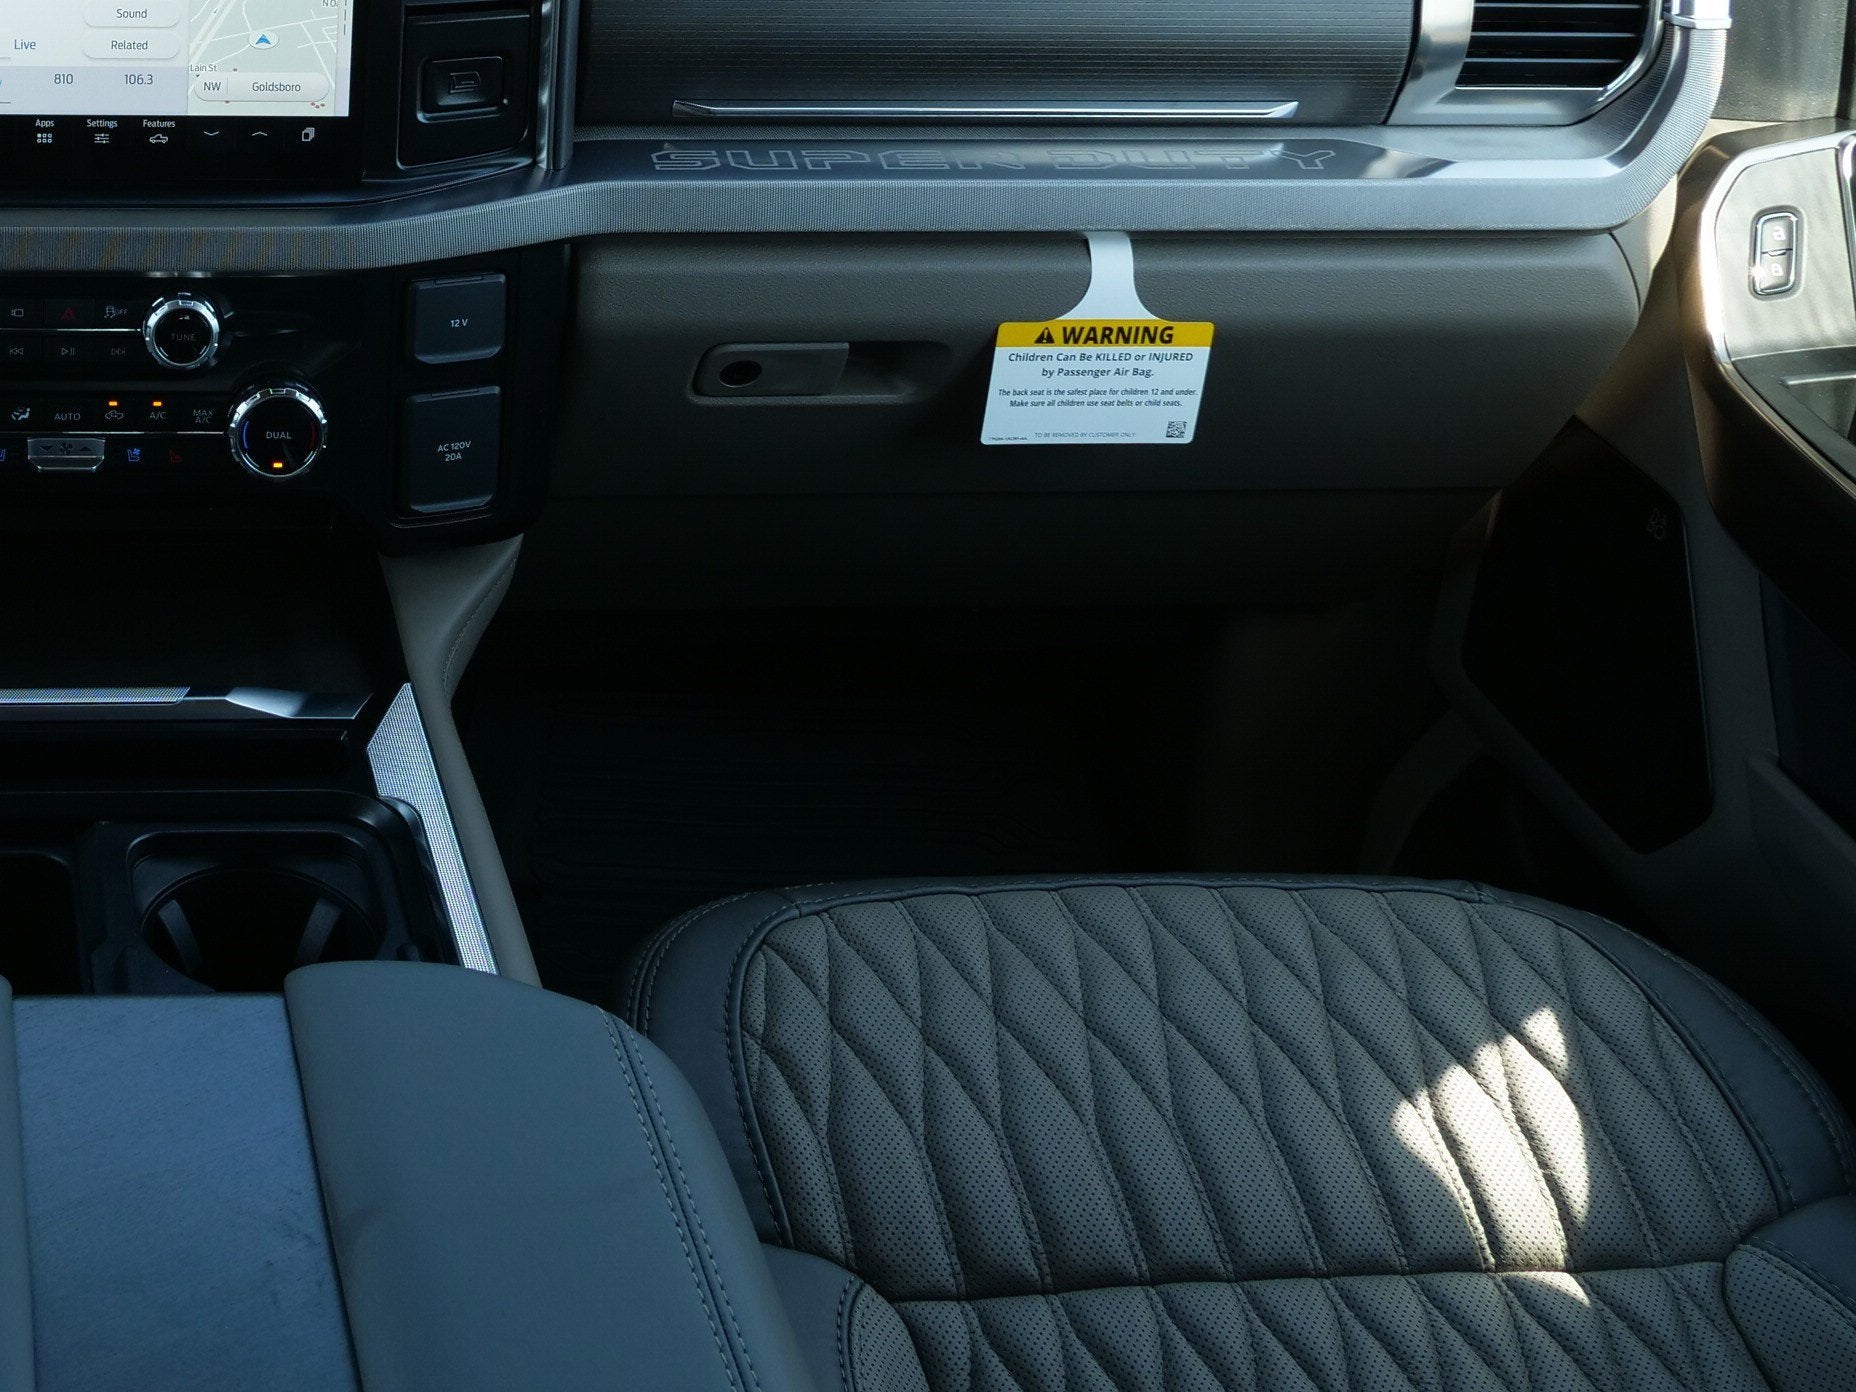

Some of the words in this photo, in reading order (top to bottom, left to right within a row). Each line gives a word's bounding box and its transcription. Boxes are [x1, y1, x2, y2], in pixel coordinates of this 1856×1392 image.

[116, 8, 148, 20] Sound
[14, 39, 36, 51] Live
[111, 40, 148, 52] Related
[54, 74, 73, 85] 810
[124, 74, 153, 85] 106.3
[204, 83, 221, 91] NW
[252, 83, 301, 91] Goldsboro
[35, 118, 54, 129] Apps
[86, 119, 118, 129] Settings
[143, 119, 176, 128] Features
[652, 149, 1026, 171] SUPER
[1062, 326, 1174, 345] WARNING
[1008, 352, 1053, 362] Children
[1056, 353, 1076, 362] Can
[1079, 353, 1092, 362] Be
[1095, 352, 1132, 362] KILLED
[1134, 354, 1146, 362] or
[1148, 352, 1193, 362] INJURED
[1042, 368, 1054, 378] by
[1057, 368, 1110, 378] Passenger
[1114, 368, 1129, 376] Air
[1132, 368, 1154, 379] Bag.
[998, 388, 1010, 396] The
[1012, 388, 1028, 396] back
[1054, 388, 1066, 396] the
[1067, 388, 1088, 396] safest
[1089, 388, 1107, 398] place
[1108, 388, 1119, 396] for
[1121, 388, 1149, 396] children
[1151, 388, 1158, 396] 12
[1160, 388, 1174, 396] and
[1175, 388, 1198, 396] under.
[1010, 399, 1028, 407] Make
[1047, 399, 1056, 407] all
[1057, 399, 1086, 408] children
[1101, 400, 1115, 408] seat
[1117, 399, 1134, 408] belts
[1145, 399, 1161, 408] child
[1163, 400, 1182, 408] seats.
[54, 412, 80, 421] AUTO
[150, 412, 166, 420] A/C
[194, 416, 212, 424] A/C
[265, 430, 292, 440] DUAL
[438, 444, 449, 452] AC
[451, 441, 471, 450] 120V
[445, 453, 462, 461] 20A
